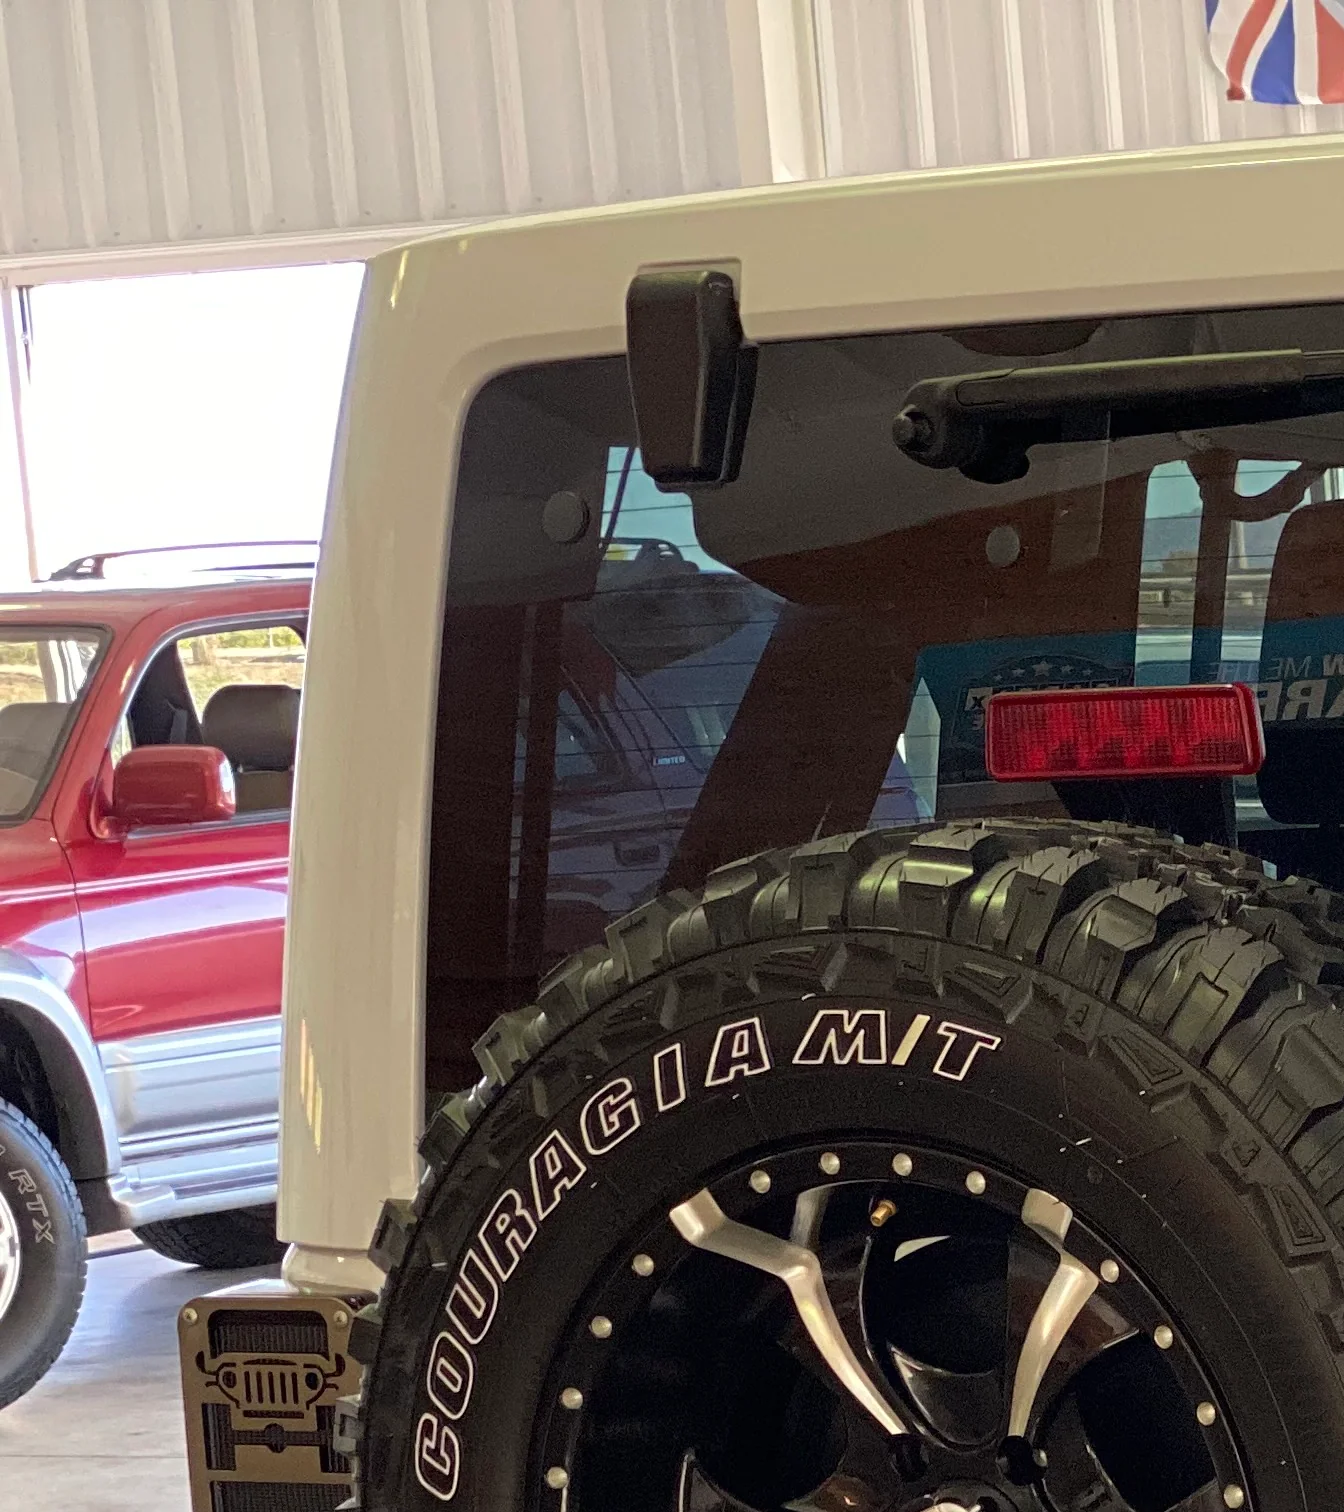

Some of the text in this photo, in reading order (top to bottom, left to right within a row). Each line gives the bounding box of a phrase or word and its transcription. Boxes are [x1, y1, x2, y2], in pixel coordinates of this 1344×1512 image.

[8, 1168, 55, 1244] RTX
[414, 1006, 1002, 1502] COURAGIA M/T
